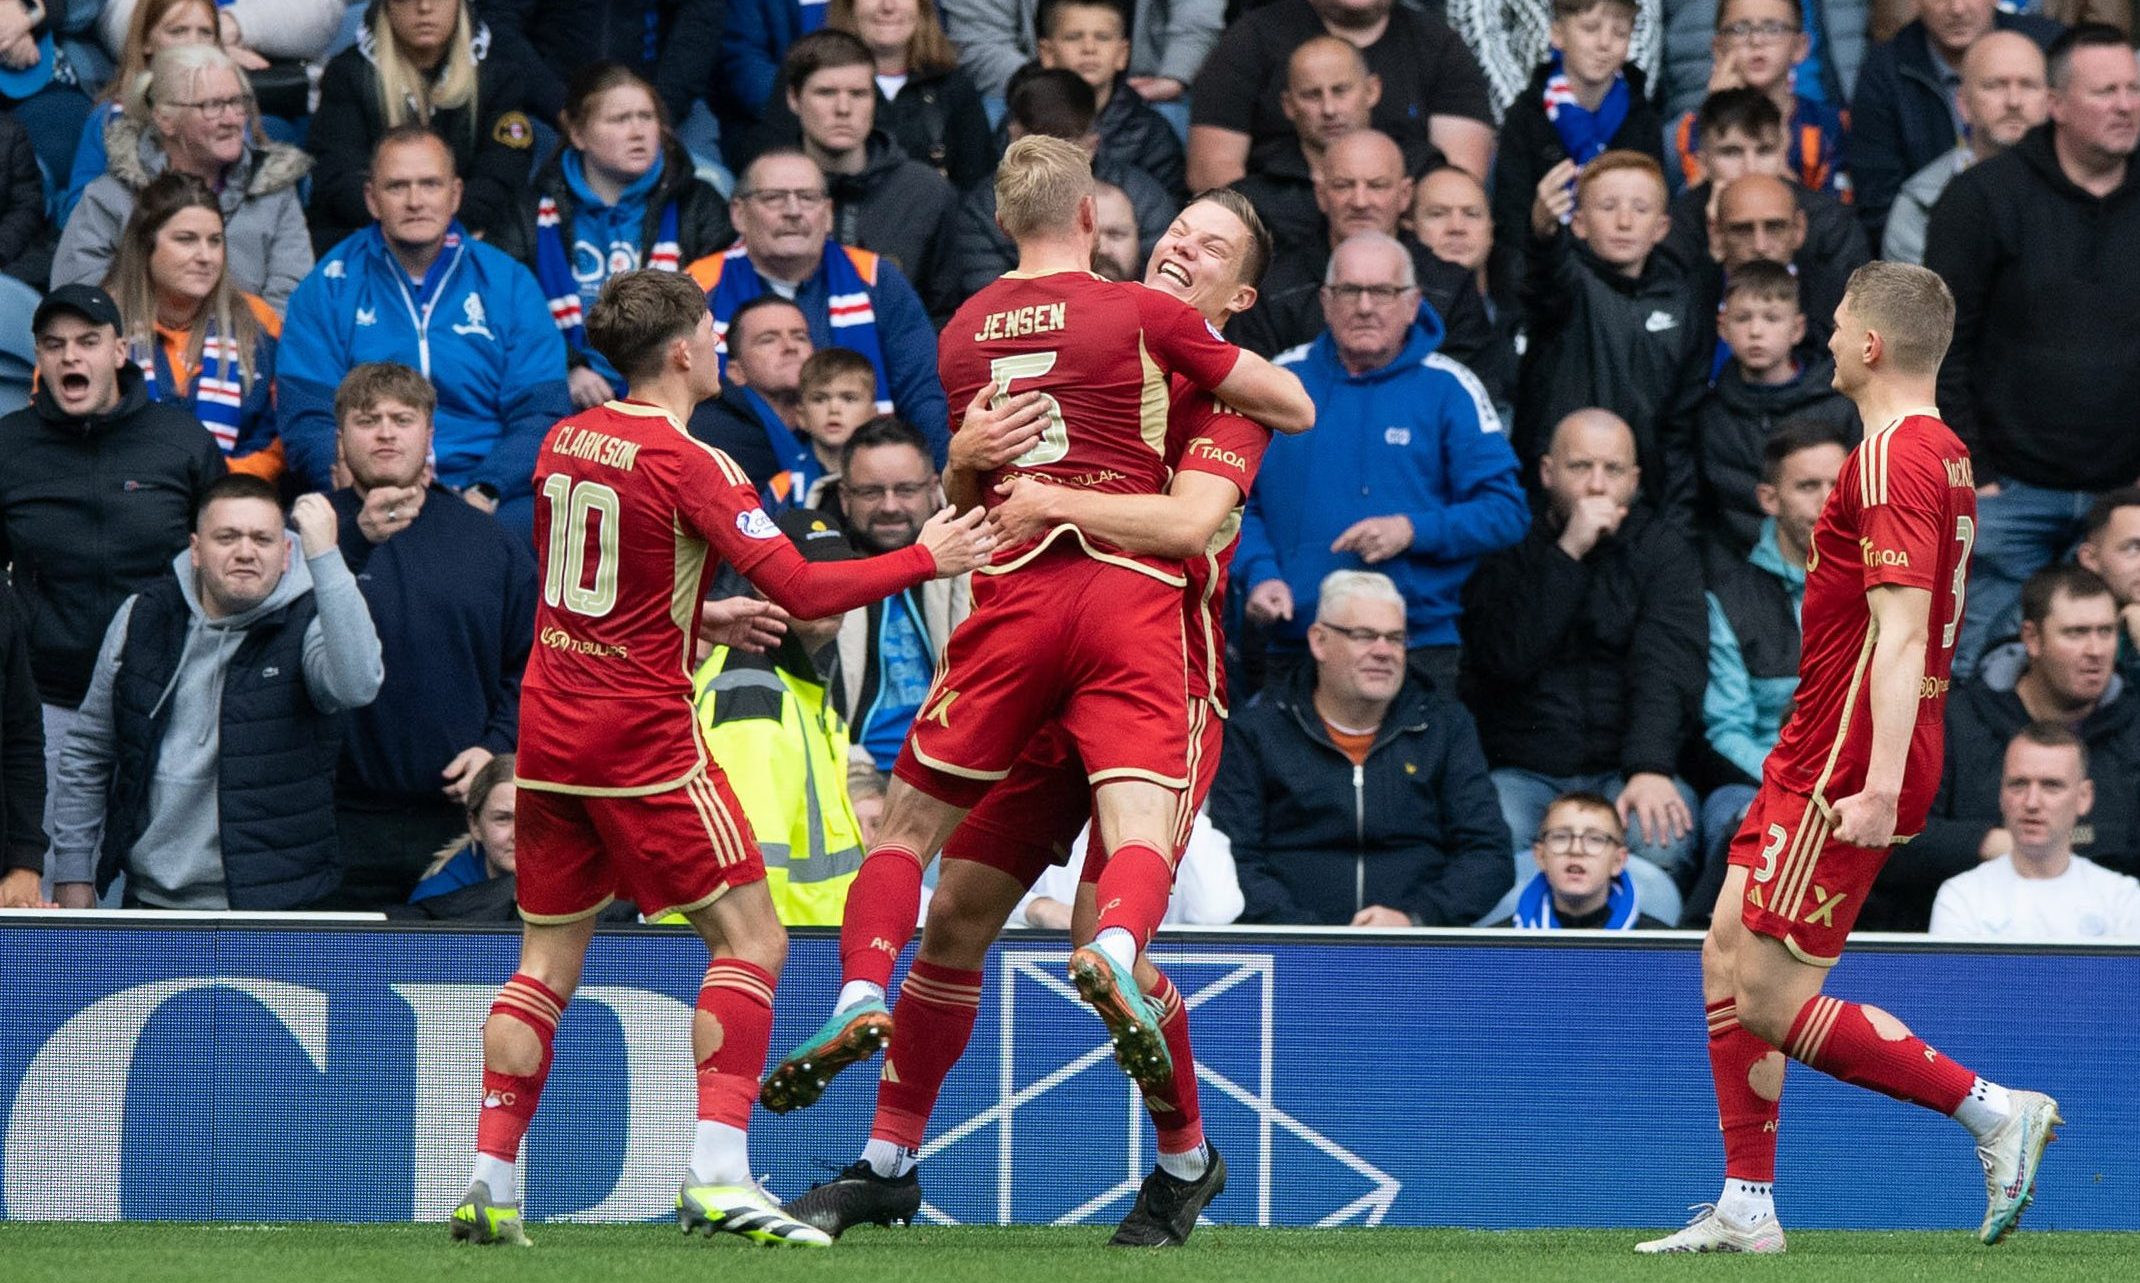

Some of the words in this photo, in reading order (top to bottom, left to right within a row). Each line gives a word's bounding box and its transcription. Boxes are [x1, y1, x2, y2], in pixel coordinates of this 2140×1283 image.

[974, 302, 1067, 342] JENSEN
[990, 351, 1069, 468] 5
[552, 425, 642, 472] CLARKSON
[1201, 445, 1246, 473] TAQA
[543, 473, 620, 617] 10
[1869, 549, 1910, 568] TAQA
[1942, 515, 1975, 648] 3
[1753, 822, 1788, 883] 3
